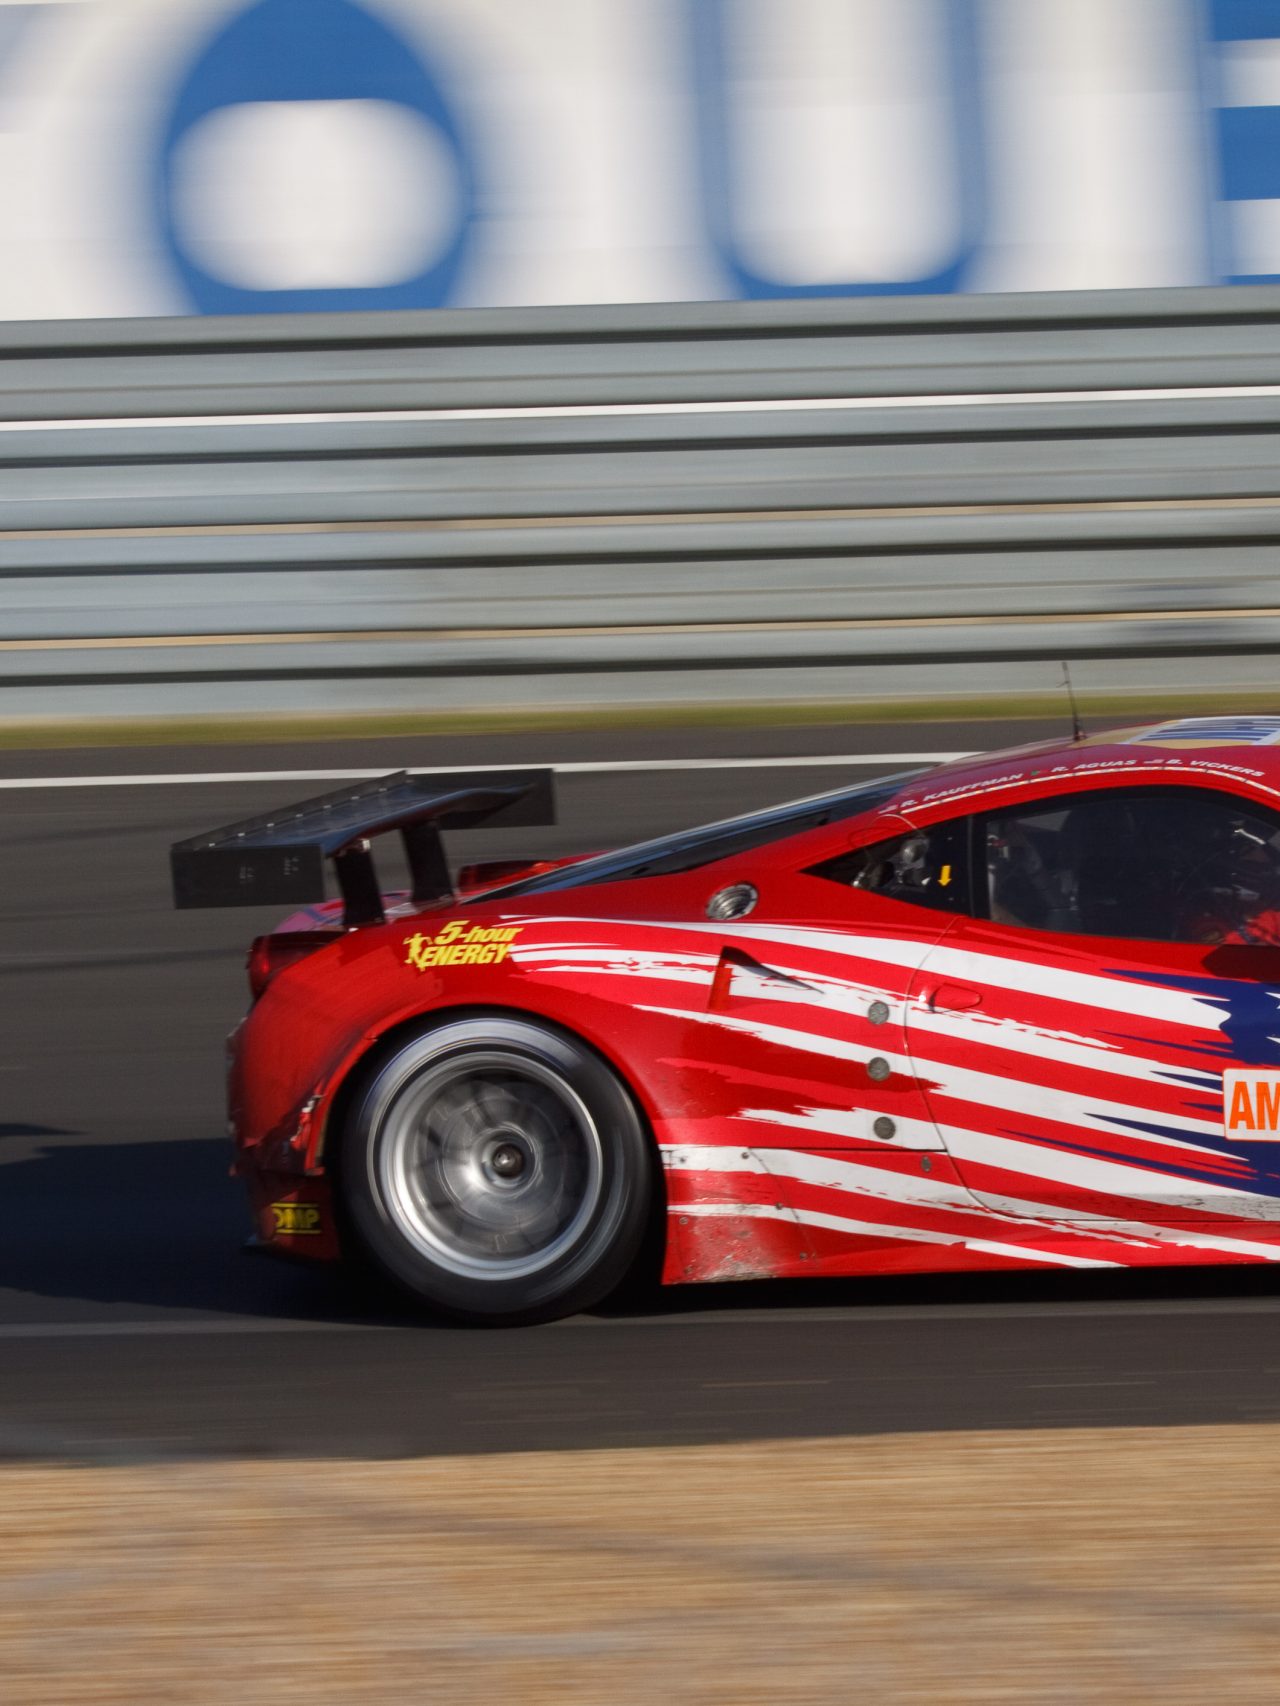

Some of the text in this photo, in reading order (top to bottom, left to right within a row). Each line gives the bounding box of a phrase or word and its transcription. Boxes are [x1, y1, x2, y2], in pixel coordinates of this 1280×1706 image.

[1190, 760, 1265, 778] VICKERS
[923, 773, 1024, 801] KAUFFMAN
[433, 920, 525, 946] 5-hour
[419, 943, 516, 968] ENERGY
